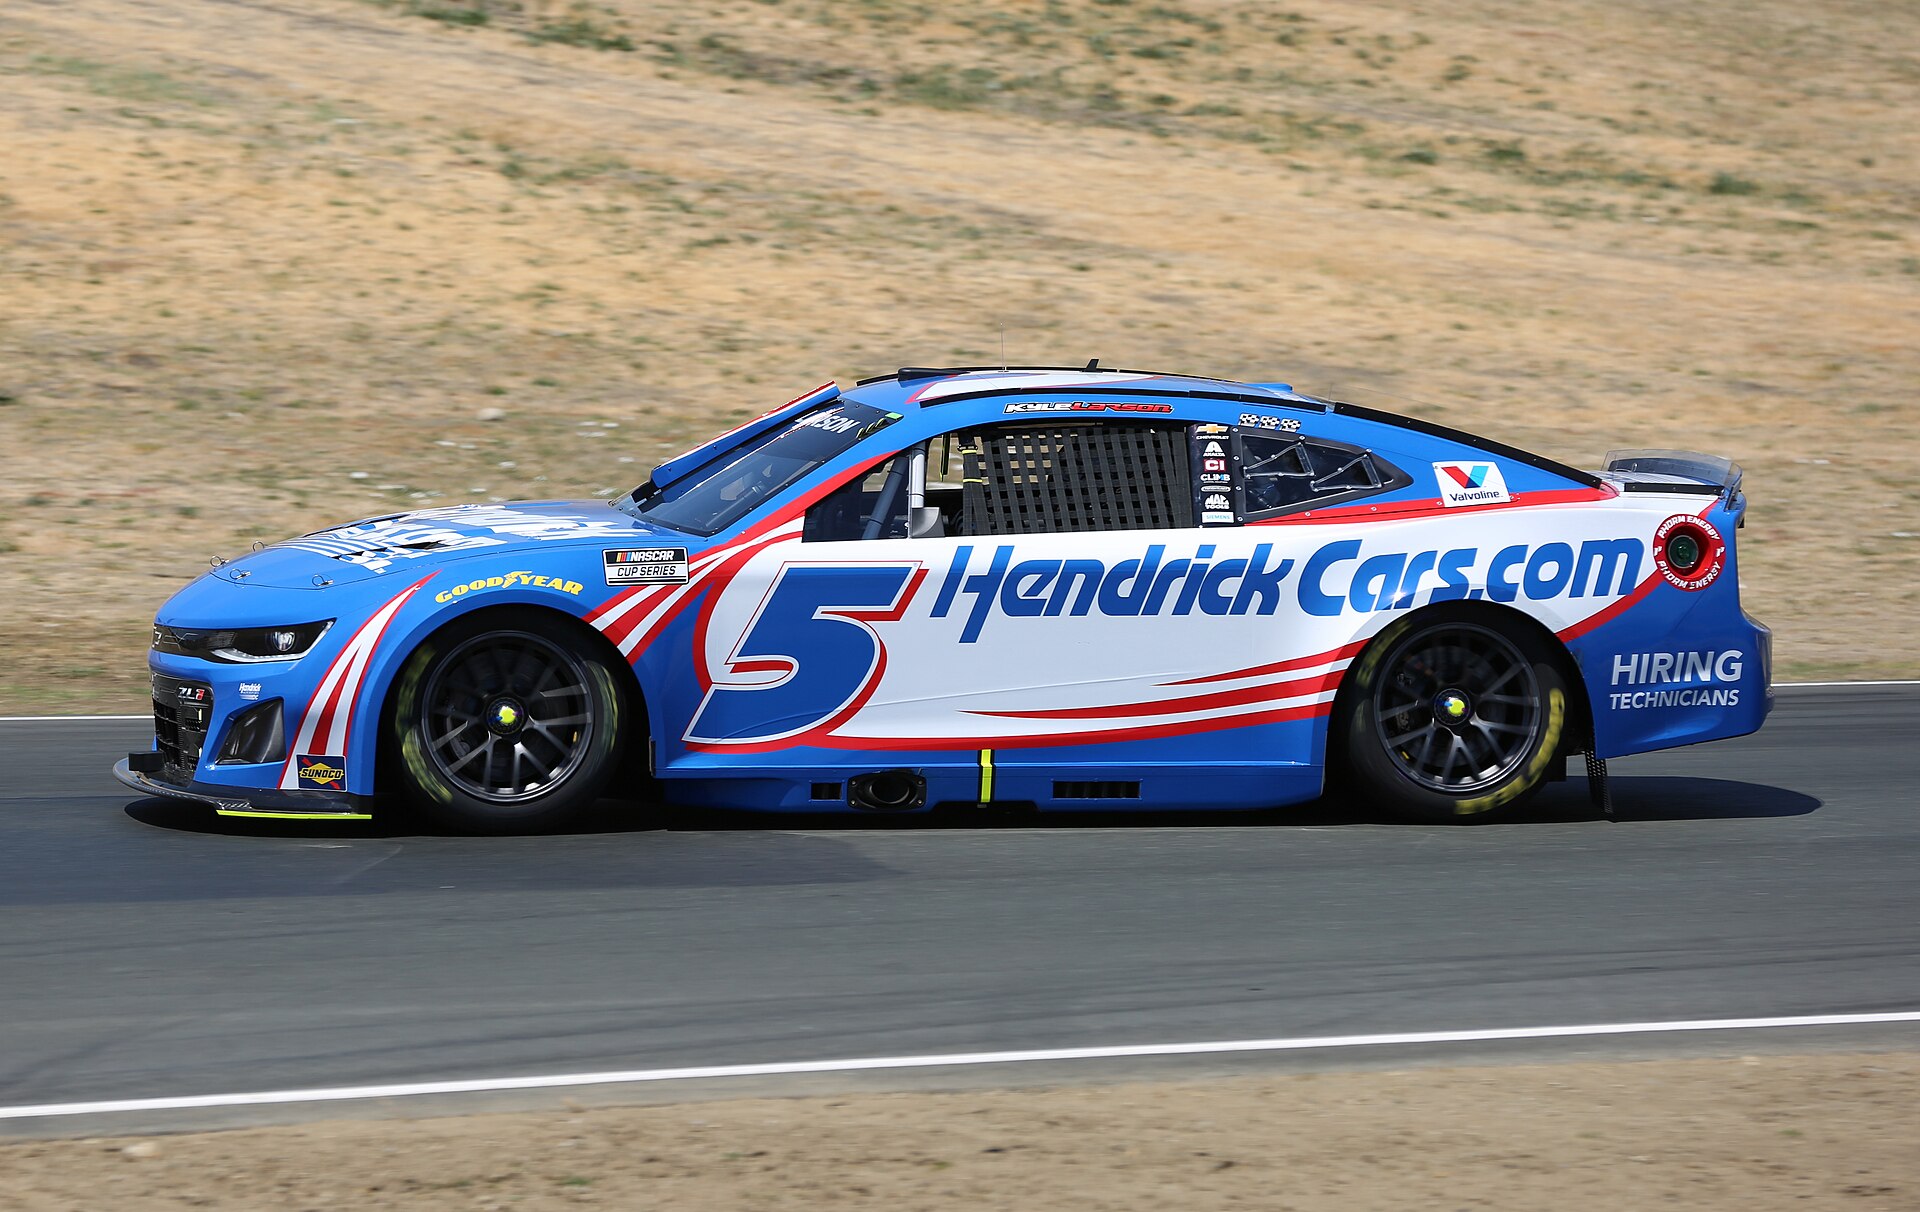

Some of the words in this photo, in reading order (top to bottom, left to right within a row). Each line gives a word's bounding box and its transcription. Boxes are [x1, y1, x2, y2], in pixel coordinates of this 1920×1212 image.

[1205, 459, 1225, 471] CI
[1449, 490, 1500, 502] Valvoline
[1657, 515, 1687, 539] PHORM
[1686, 515, 1721, 540] ENERGY
[629, 550, 675, 562] NASCAR
[617, 567, 639, 577] CUP
[640, 566, 677, 576] SERIES
[1657, 560, 1688, 589] PHORM
[1688, 561, 1721, 590] ENERGY
[435, 571, 584, 603] GOODYEAR
[681, 561, 926, 746] 5
[1611, 650, 1744, 685] HIRING
[1610, 689, 1740, 710] TECHNICIANS
[301, 768, 342, 779] SUNOCO
